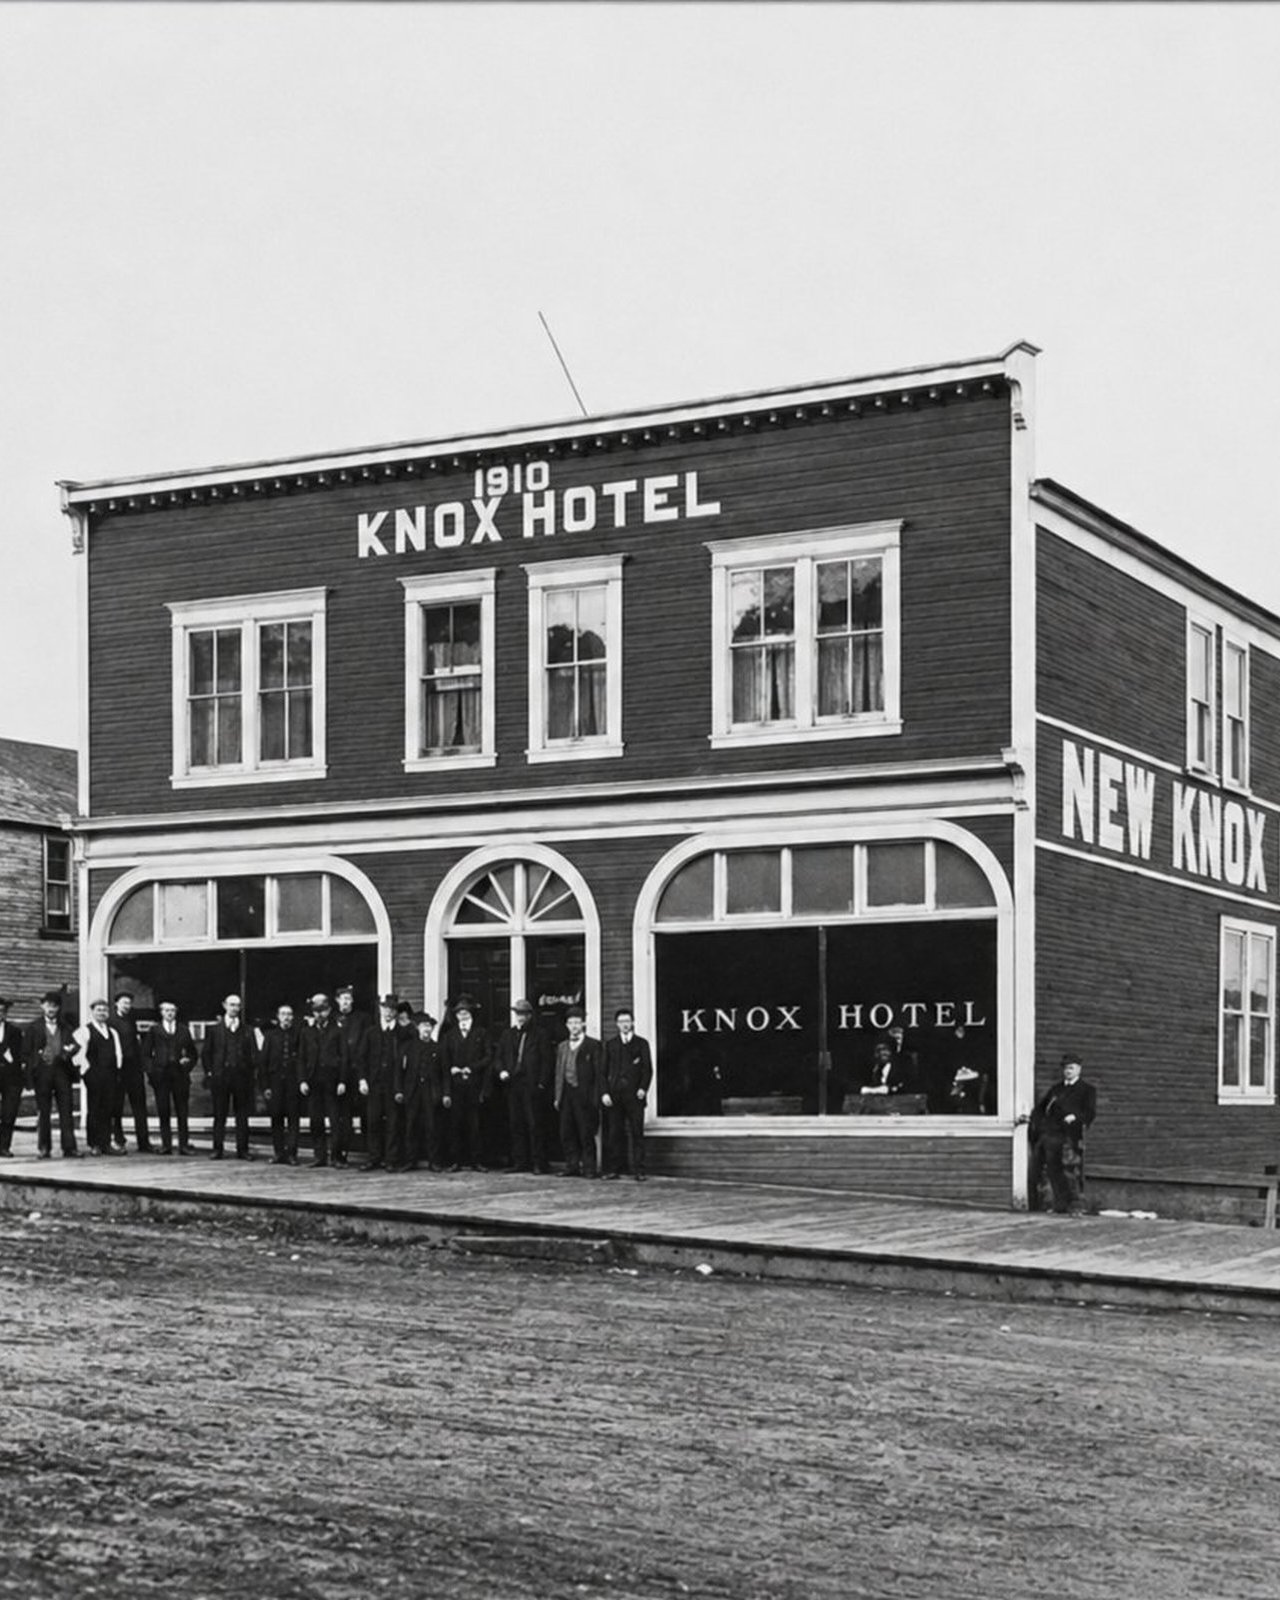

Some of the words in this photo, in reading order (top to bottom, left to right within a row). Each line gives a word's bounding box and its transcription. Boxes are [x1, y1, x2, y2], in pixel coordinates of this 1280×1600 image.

[474, 461, 550, 498] 1910
[357, 497, 503, 558] KNOX
[522, 471, 721, 539] HOTEL
[1062, 738, 1156, 861] NEW
[1172, 780, 1268, 893] KNOX
[680, 1006, 803, 1032] KNOX
[837, 1002, 987, 1029] HOTEL
